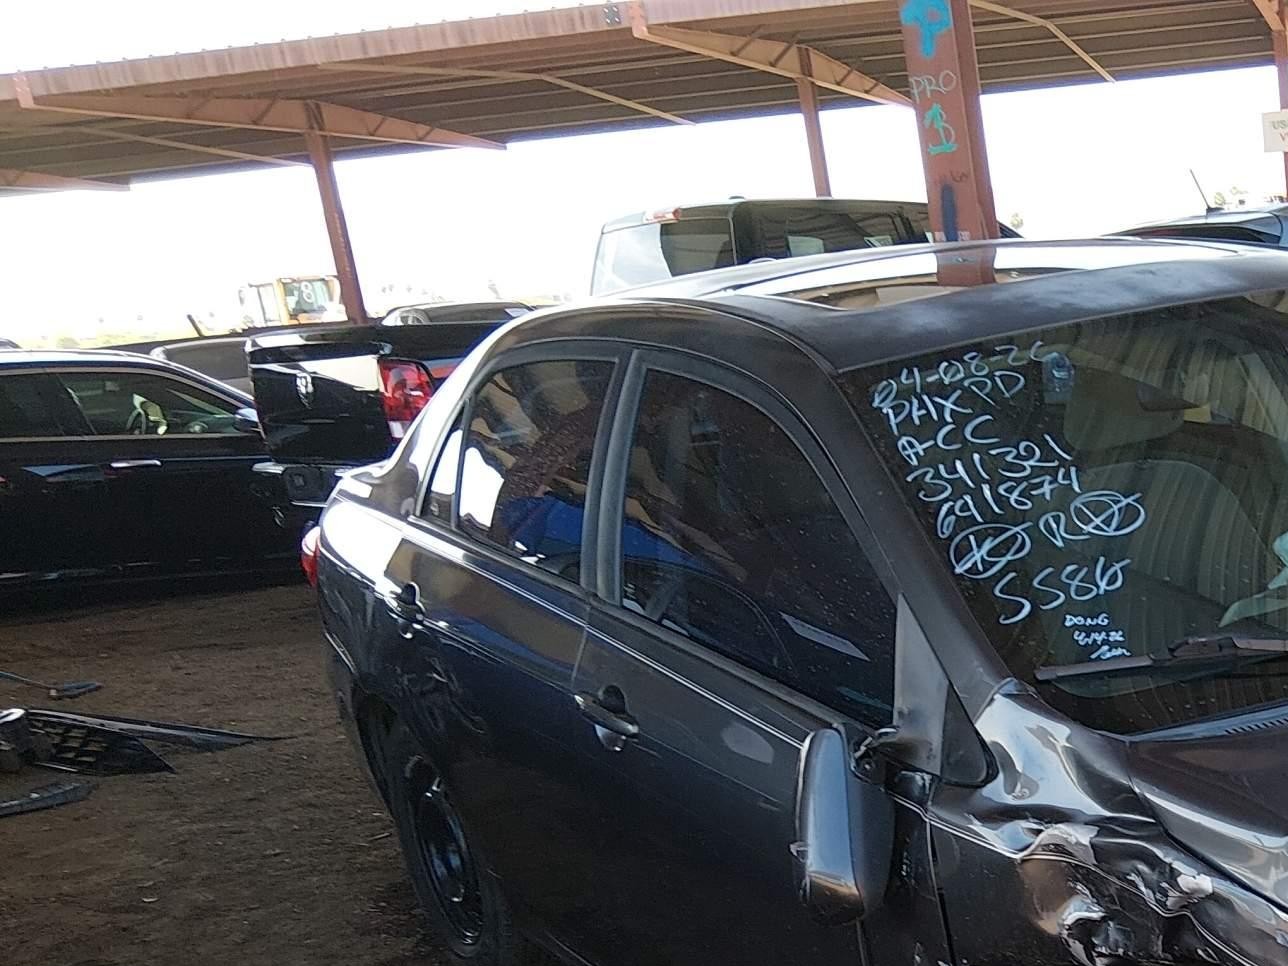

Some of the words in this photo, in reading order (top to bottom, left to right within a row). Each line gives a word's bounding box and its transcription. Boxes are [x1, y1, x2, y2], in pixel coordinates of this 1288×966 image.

[910, 70, 957, 104] PRO
[963, 370, 1025, 410] PD
[897, 414, 1001, 466] ACC
